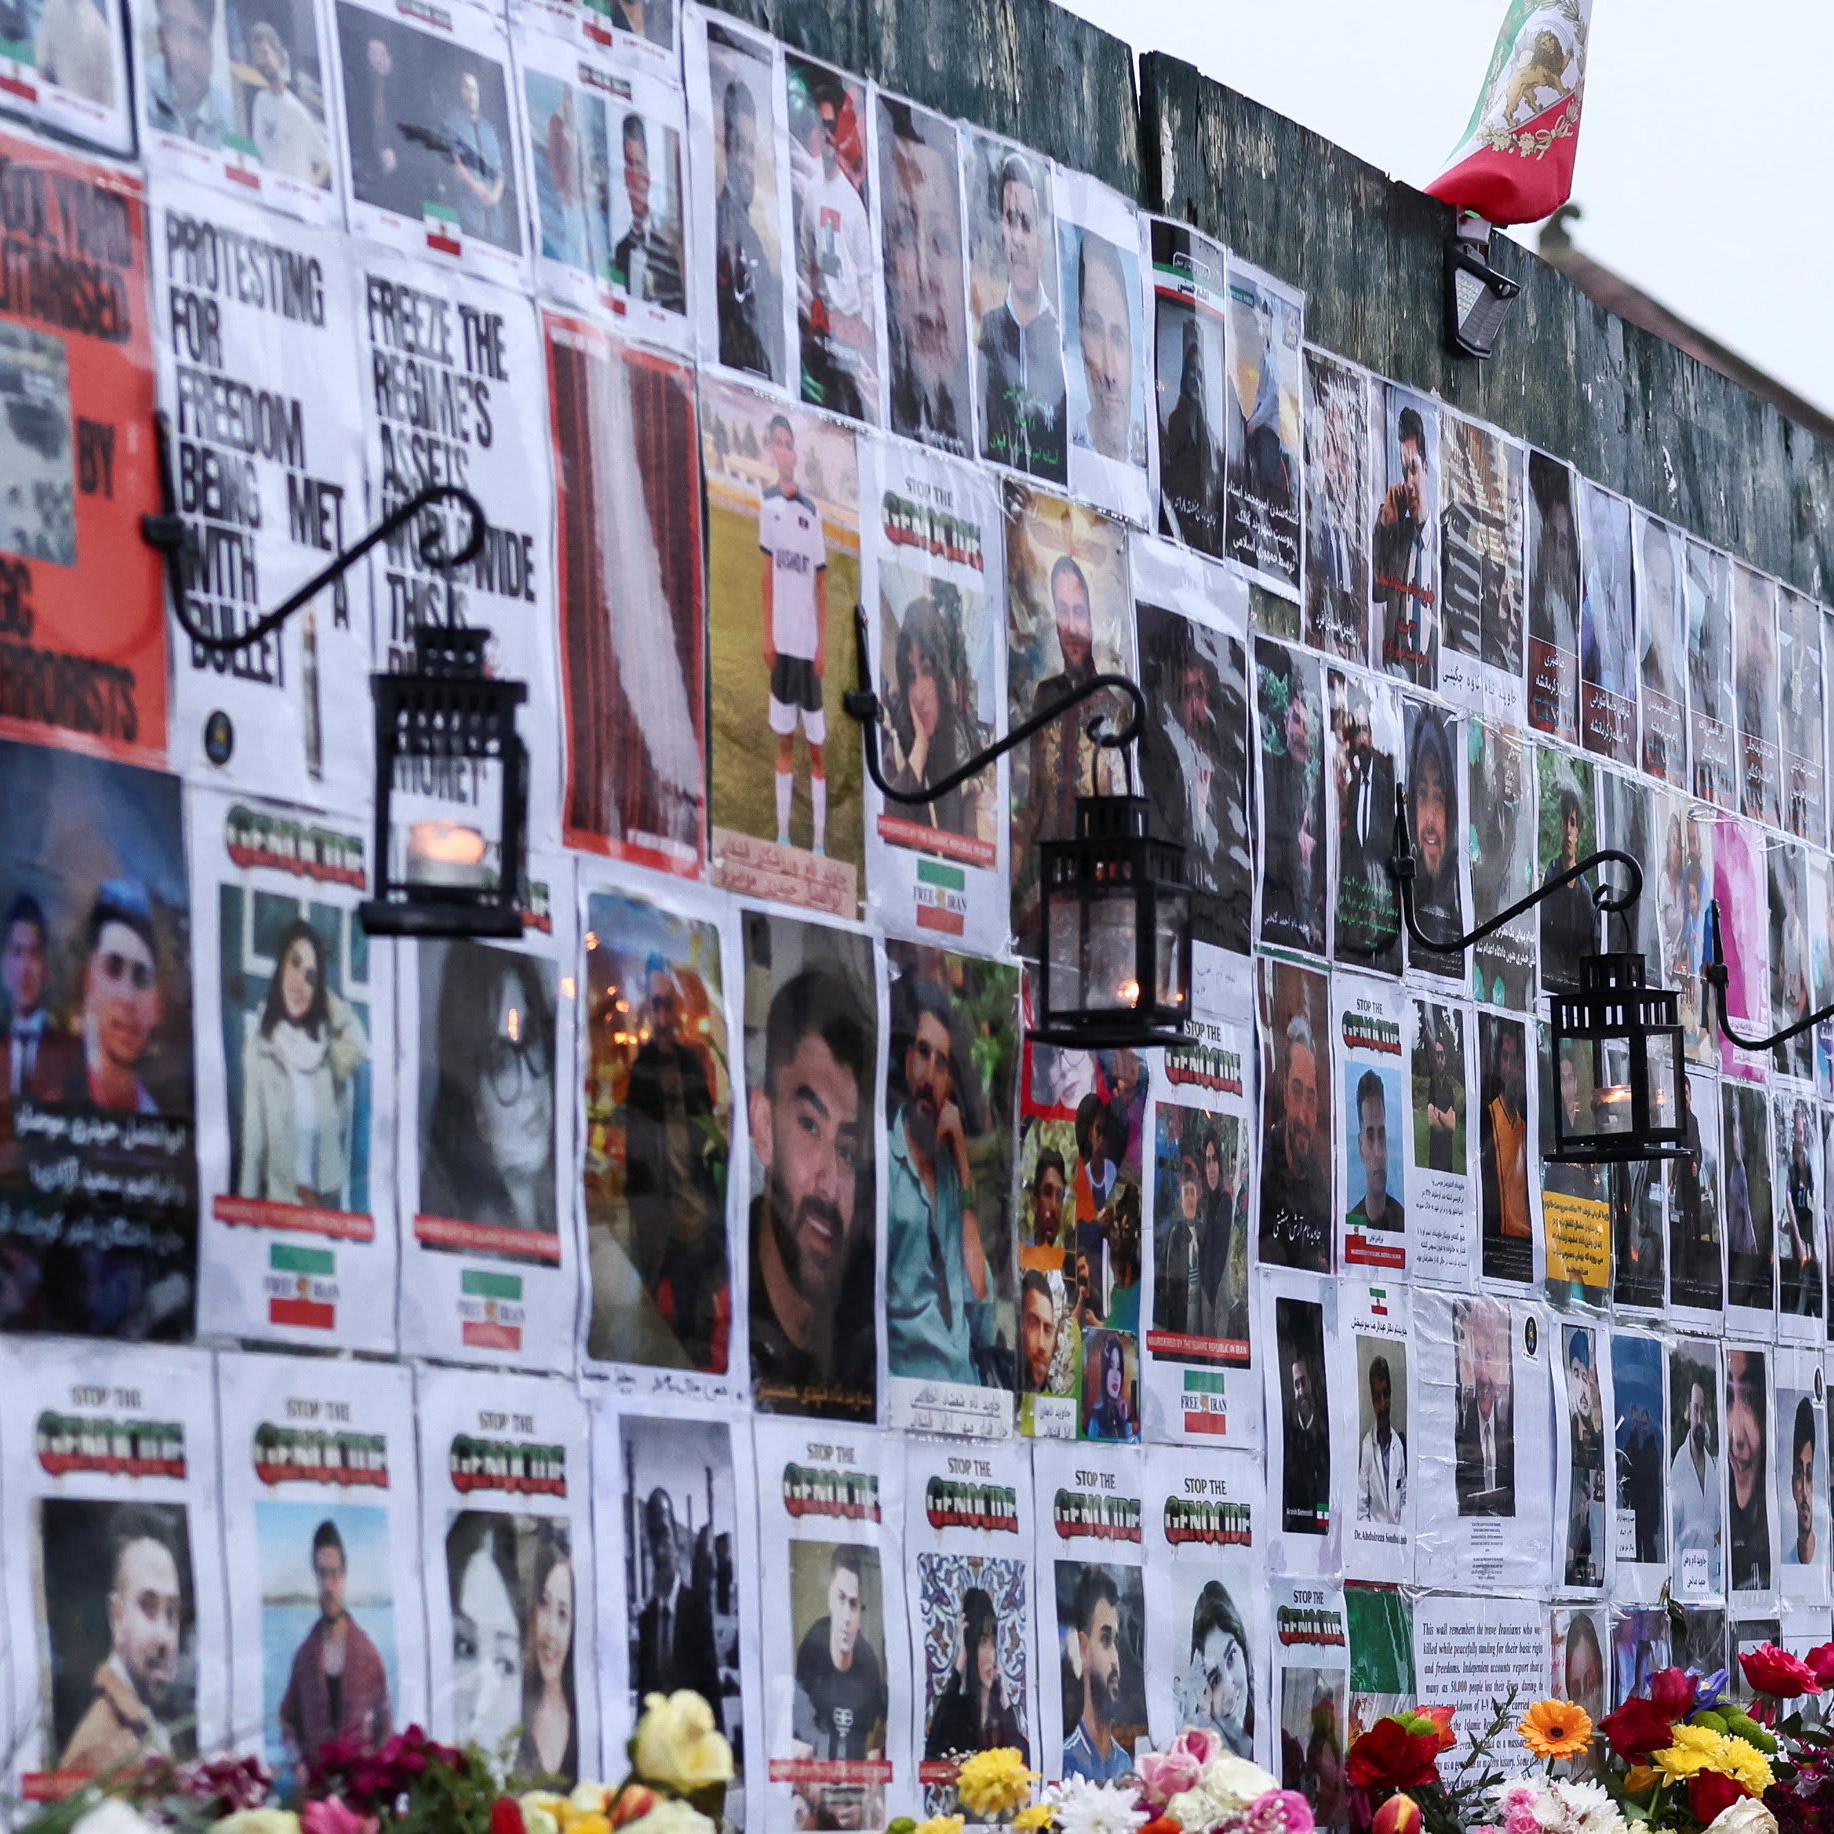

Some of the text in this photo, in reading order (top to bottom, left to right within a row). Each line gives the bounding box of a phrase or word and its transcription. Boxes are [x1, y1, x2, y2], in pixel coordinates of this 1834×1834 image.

[166, 208, 324, 327] PROTESTING
[171, 286, 222, 369] FOR
[367, 274, 508, 381] FREEZE THE
[177, 365, 305, 468] FREEDOM
[373, 349, 492, 448] REGIME'S
[77, 417, 115, 498] BY
[380, 422, 470, 500] ASSETS
[180, 443, 347, 554] BEING MET
[882, 490, 984, 573] GENOCIDE
[183, 520, 257, 603] WITH
[387, 573, 440, 642] THIS
[191, 599, 284, 688] BULLET
[227, 803, 366, 890] GENOCIDE
[913, 886, 967, 911] FREE IRAN
[1356, 998, 1383, 1015] STOP THE
[1186, 1020, 1222, 1042] STOP THE
[1342, 1010, 1402, 1056] GENOCIDE
[1165, 1044, 1243, 1098] GENOCIDE
[1209, 1342, 1229, 1354] REPUBLIC
[1235, 1345, 1248, 1355] IRAN
[71, 1384, 143, 1411] STOP THE
[287, 1397, 352, 1423] STOP THE
[1181, 1395, 1228, 1412] FREE IRAN
[37, 1410, 187, 1481] GENOCIDE
[479, 1411, 535, 1435] STOP THE
[254, 1420, 390, 1489] GENOCIDE
[451, 1434, 568, 1498] GENOCIDE
[807, 1443, 856, 1464] STOP THE
[948, 1457, 993, 1477] STOP THE
[783, 1462, 882, 1524] GENOCIDE
[1075, 1470, 1116, 1489] STOP THE
[1184, 1477, 1228, 1495] STOP THE
[926, 1475, 1019, 1534] GENOCIDE
[1054, 1488, 1141, 1544] GENOCIDE
[1164, 1495, 1252, 1548] GENOCIDE
[1293, 1590, 1324, 1605] STOP THE
[1277, 1605, 1346, 1648] GENOCIDE
[1423, 1622, 1434, 1635] This
[1436, 1623, 1447, 1635] wall
[1449, 1623, 1475, 1635] remembers
[1498, 1622, 1521, 1635] Iranians
[1523, 1623, 1532, 1635] who
[1423, 1642, 1438, 1654] killed
[1439, 1642, 1453, 1654] while
[1453, 1642, 1477, 1658] peacefully
[1496, 1641, 1504, 1657] for
[1505, 1642, 1518, 1654] their
[1519, 1642, 1531, 1654] basic
[1424, 1661, 1539, 1677] and freedoms. Independent accounts report that
[1426, 1684, 1439, 1697] many
[1442, 1684, 1448, 1694] as
[1469, 1680, 1483, 1697] people
[1494, 1680, 1505, 1692] their
[1522, 1679, 1536, 1695] during
[1464, 1718, 1481, 1731] Islamic
[1474, 1698, 1529, 1714] of carried
[1517, 1754, 1529, 1767] Some
